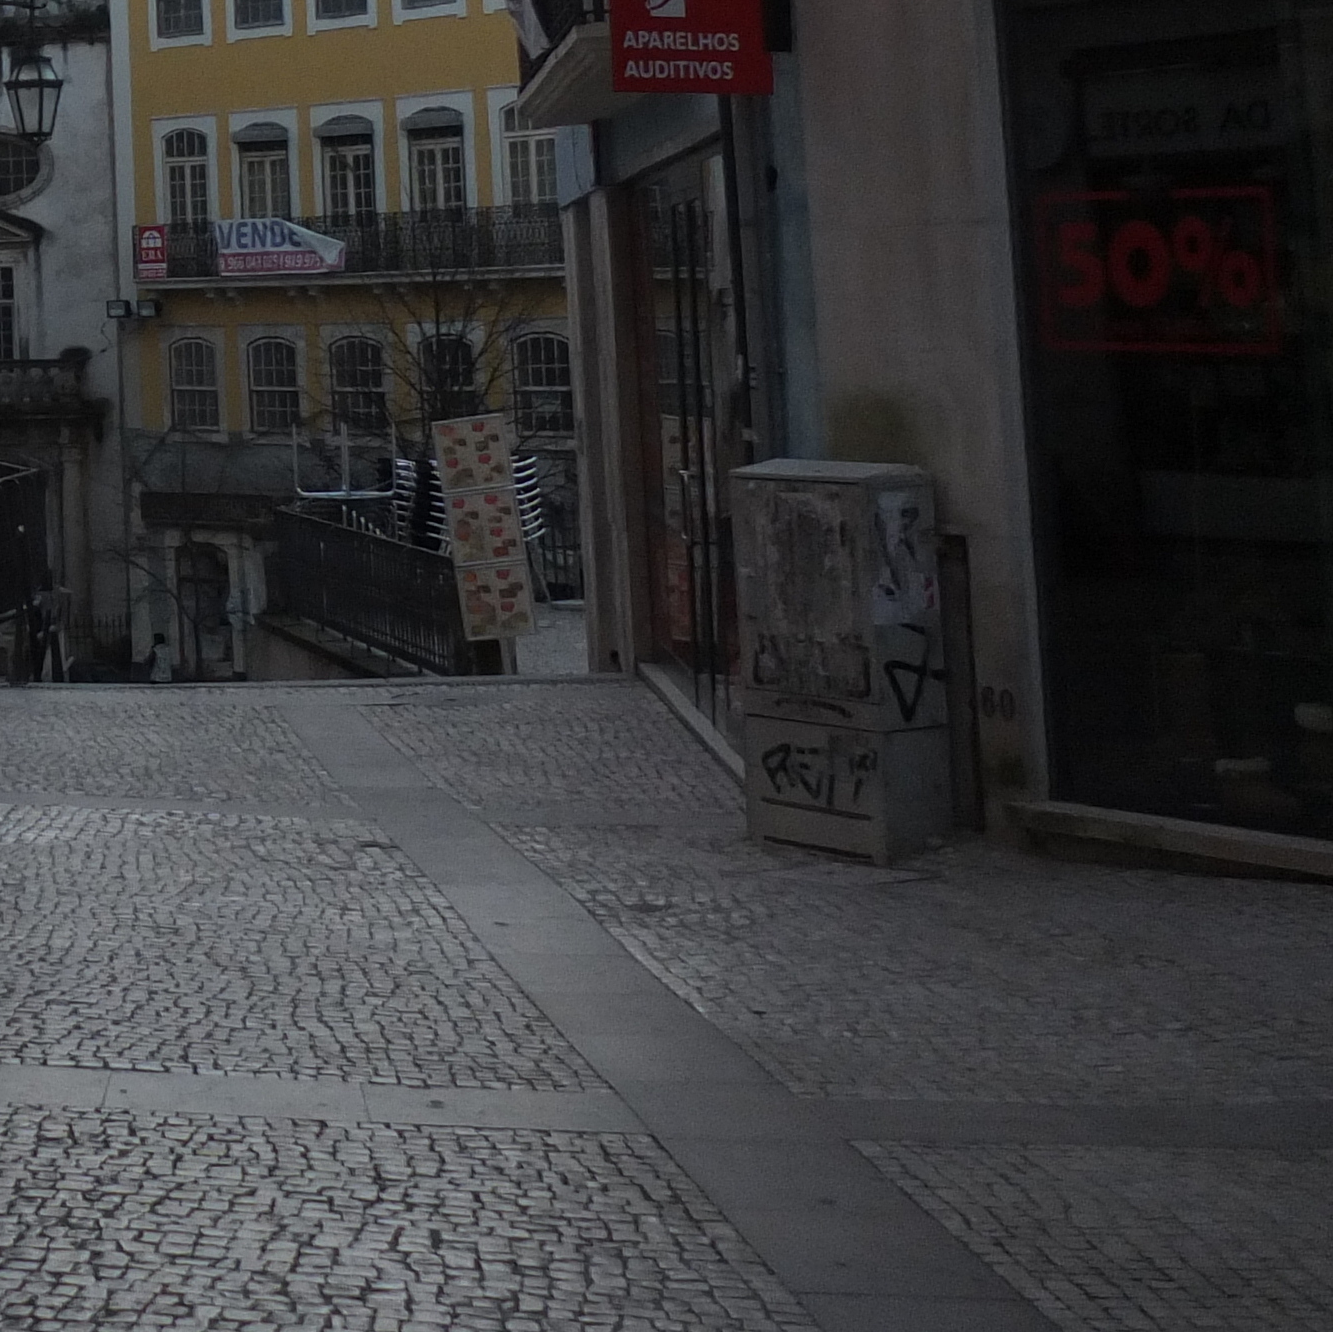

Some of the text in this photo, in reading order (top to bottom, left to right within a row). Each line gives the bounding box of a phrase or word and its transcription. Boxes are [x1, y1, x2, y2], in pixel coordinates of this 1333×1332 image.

[623, 31, 740, 52] APARELHOS
[624, 60, 734, 81] AUDITIVOS
[1057, 214, 1261, 309] 50%
